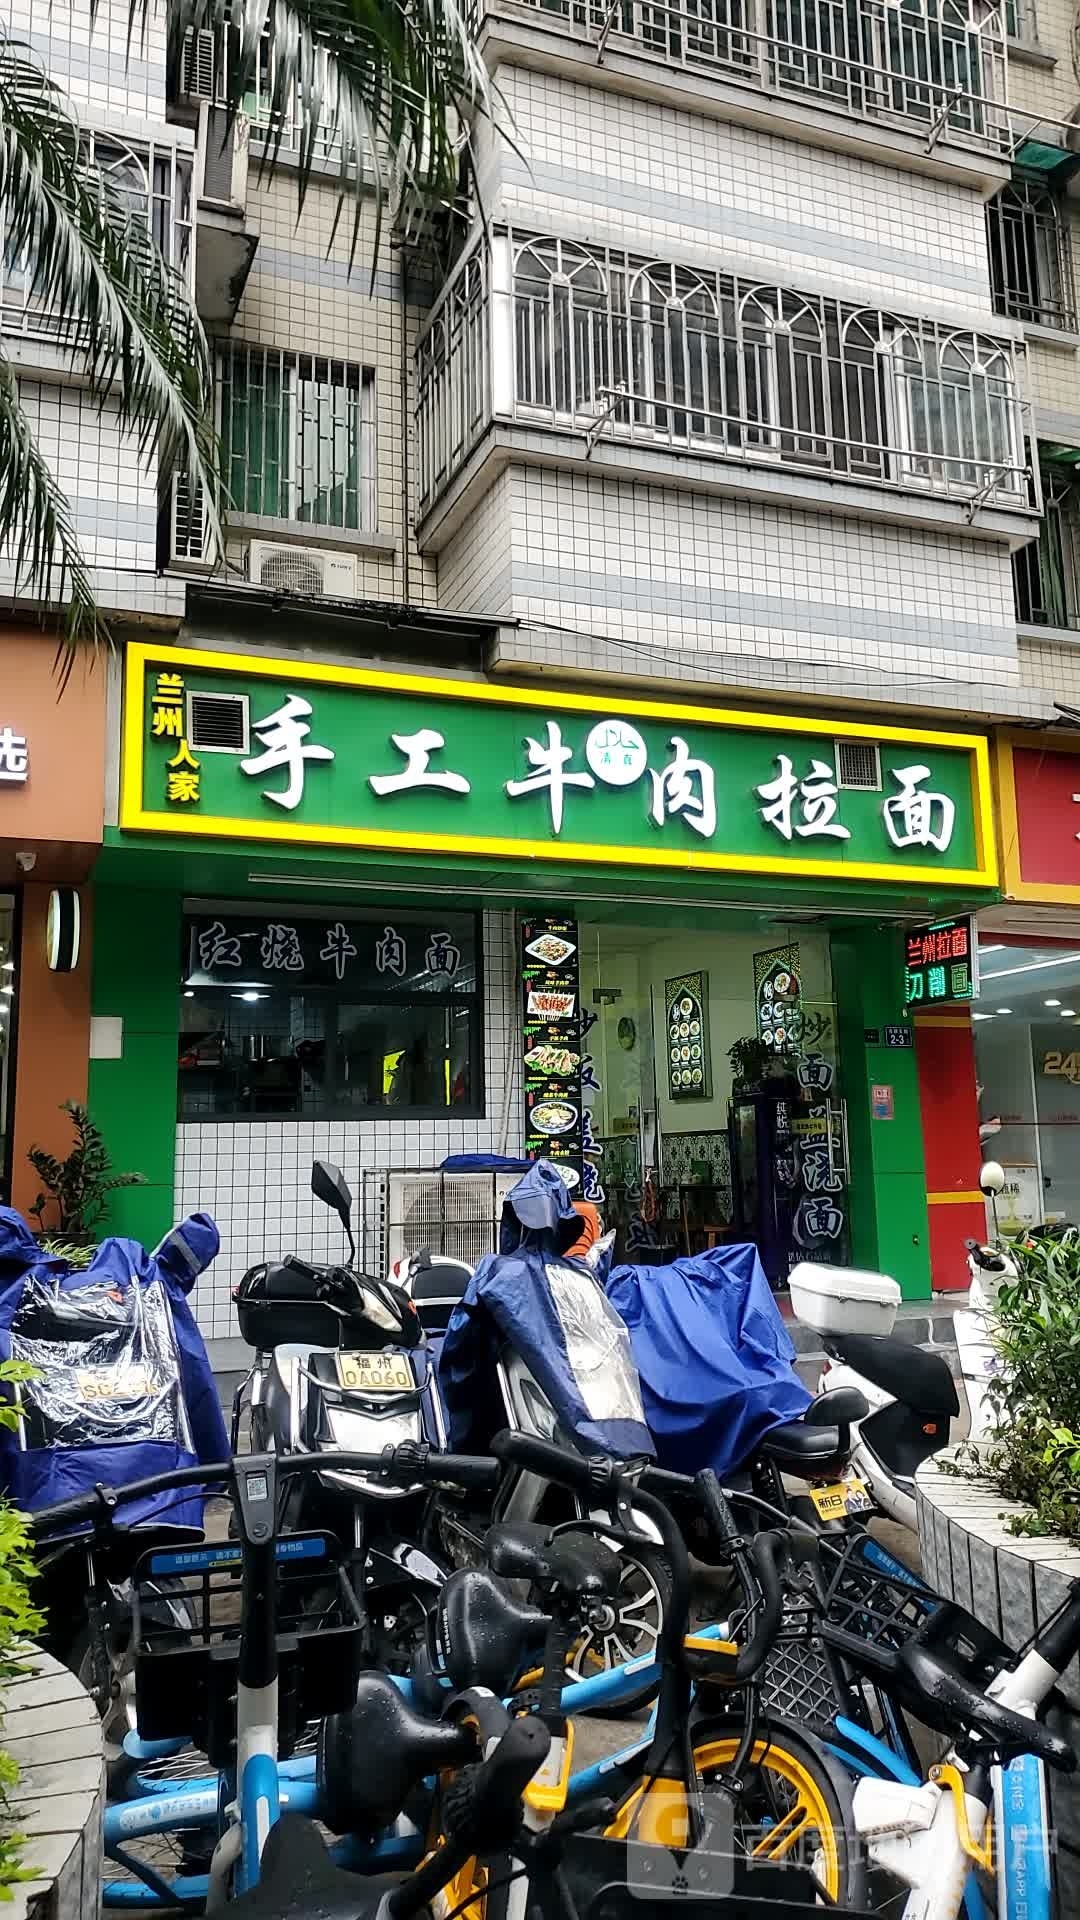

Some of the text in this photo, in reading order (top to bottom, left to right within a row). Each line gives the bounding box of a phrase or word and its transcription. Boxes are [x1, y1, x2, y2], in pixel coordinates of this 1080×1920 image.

[152, 673, 200, 801] 兰州人家
[240, 694, 956, 852] 手工牛肉拉面
[199, 921, 460, 980] 红烧牛肉面
[908, 927, 968, 966] 兰州拉面
[354, 1357, 393, 1369] 福州
[818, 1494, 843, 1509] 新日
